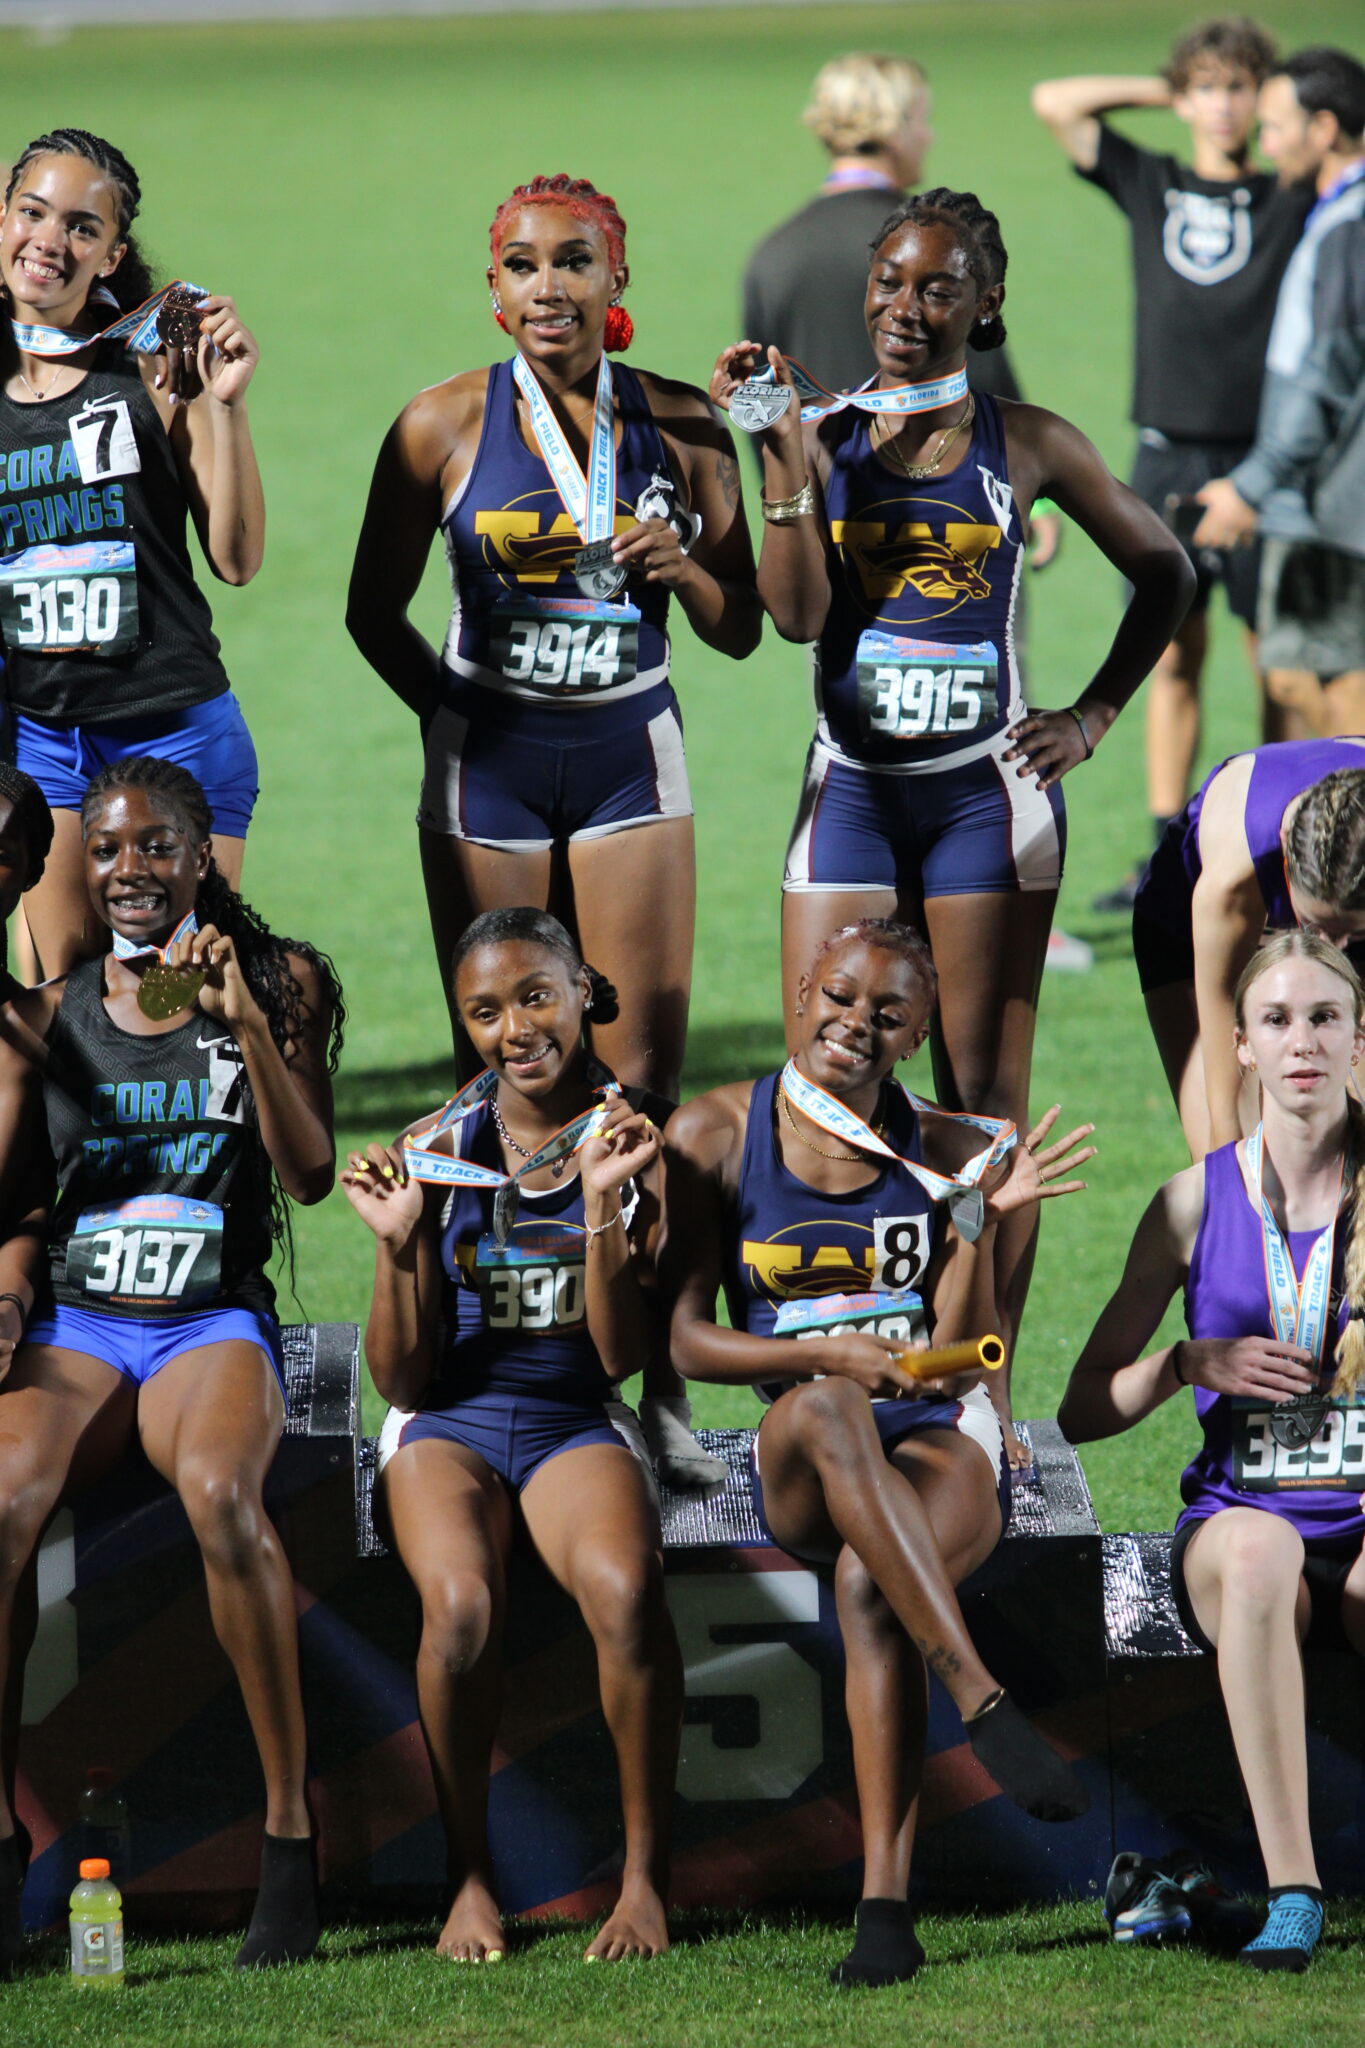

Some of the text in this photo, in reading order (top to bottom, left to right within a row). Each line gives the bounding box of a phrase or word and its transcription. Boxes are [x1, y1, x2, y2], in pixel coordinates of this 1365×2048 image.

[138, 325, 159, 352] TRA
[522, 372, 539, 408] TRACK
[540, 422, 560, 456] FIELD
[736, 385, 790, 398] FLORIDA
[909, 389, 940, 401] FLORIDA
[947, 378, 967, 395] TRA
[0, 440, 80, 494] ORA
[76, 409, 119, 474] 7
[600, 423, 608, 458] FIELD
[600, 460, 607, 469] &
[597, 471, 607, 506] TRACK
[0, 484, 124, 547] PRINGS
[12, 577, 120, 644] 3130
[502, 621, 621, 686] 3914
[870, 668, 984, 732] 3915
[217, 1049, 245, 1116] 7
[809, 1092, 849, 1131] TRACK
[433, 1163, 484, 1180] TRACK
[86, 1229, 206, 1296] 3137
[881, 1222, 921, 1289] 8
[1271, 1243, 1286, 1288] FIELD
[1308, 1260, 1325, 1312] TRACK
[1304, 1322, 1313, 1351] LORIDA
[664, 1571, 824, 1801] 5
